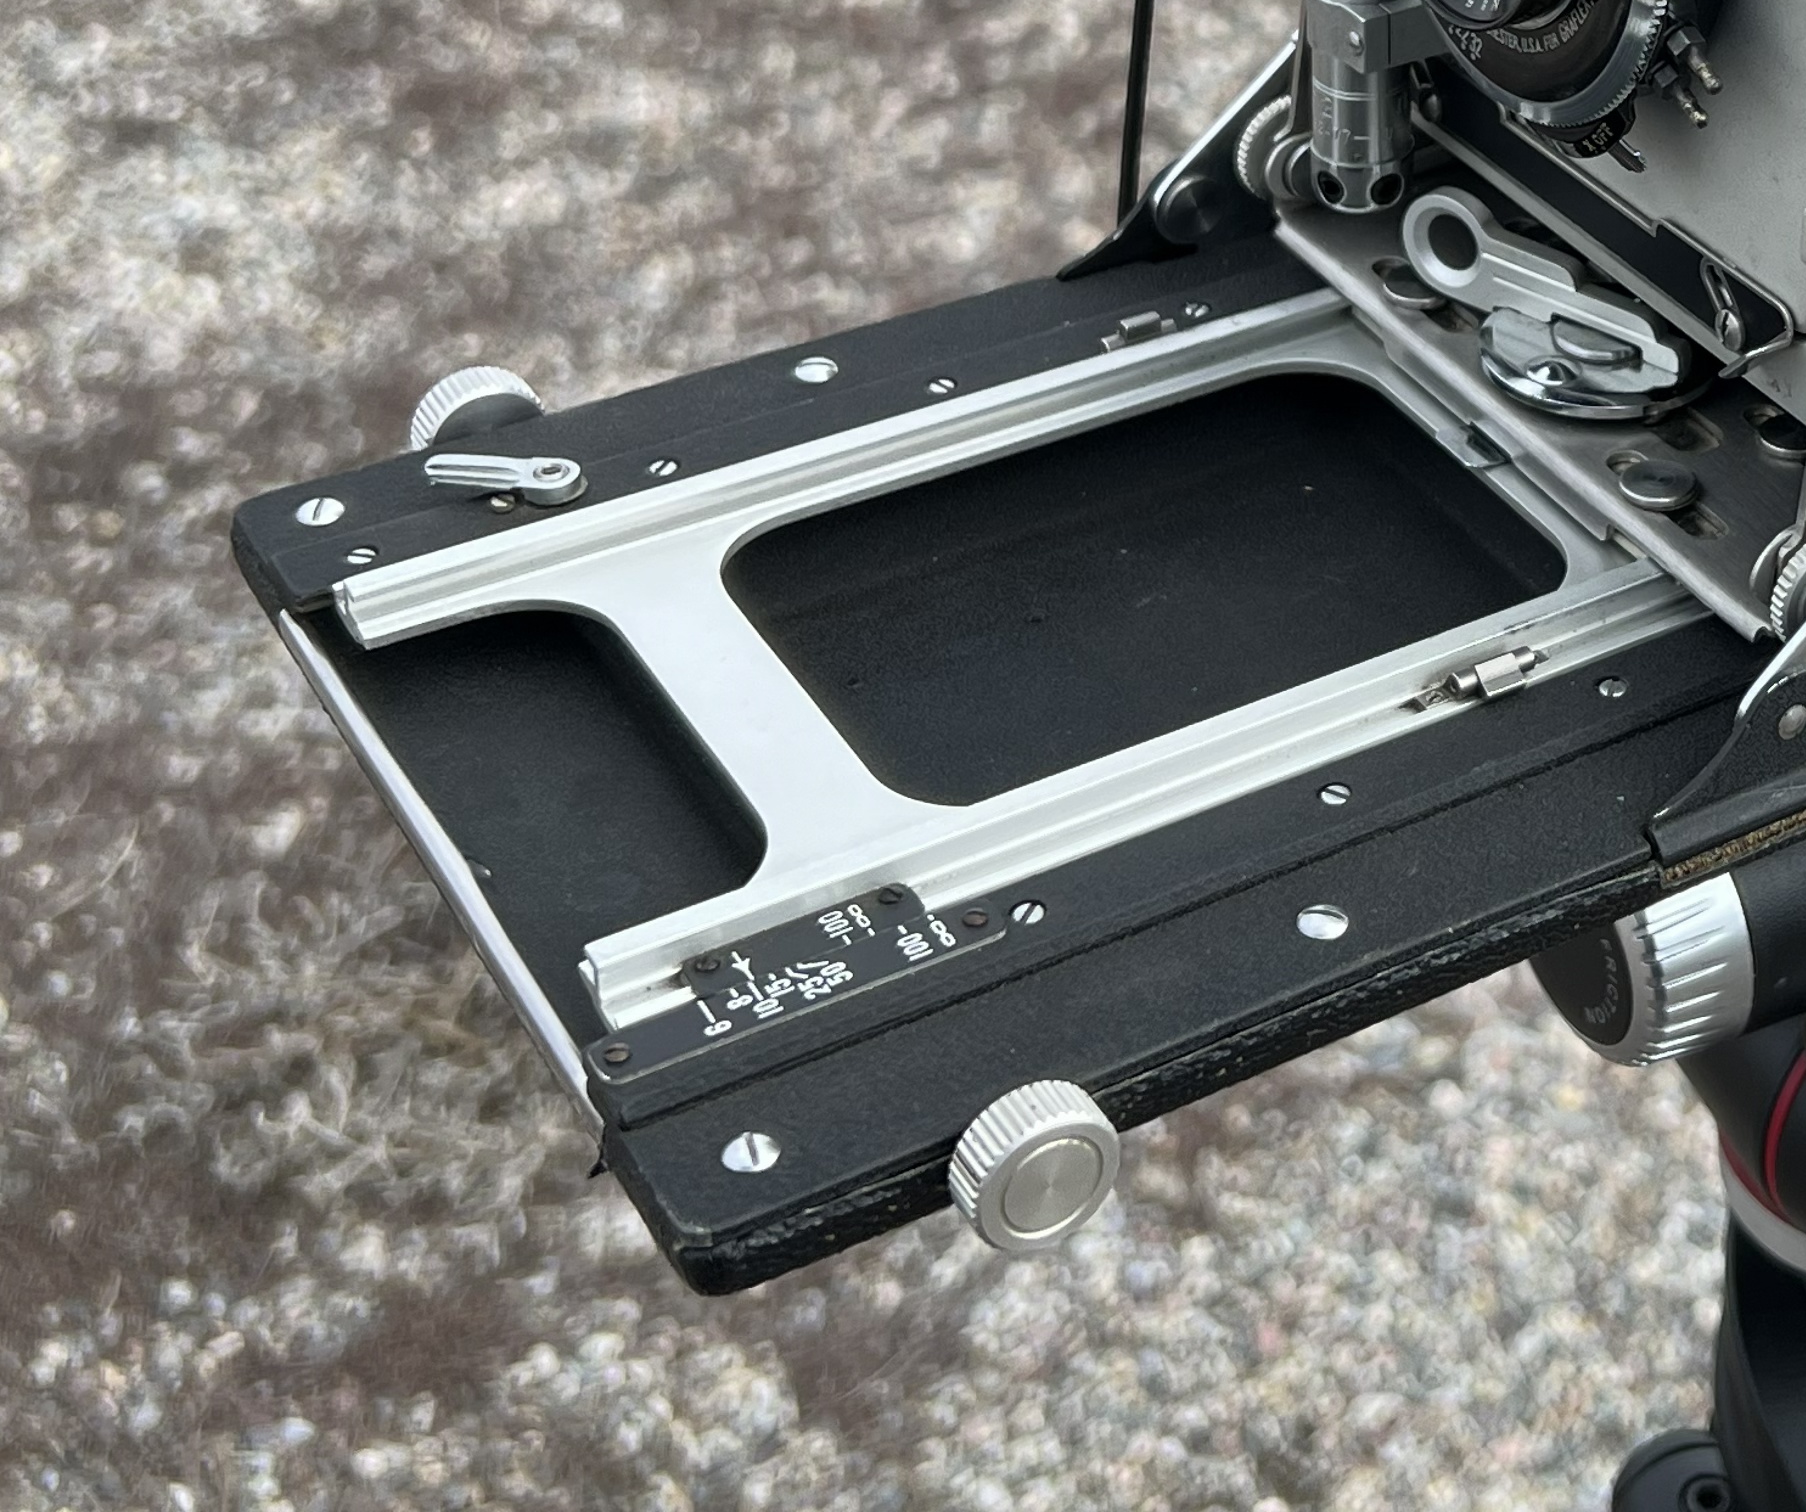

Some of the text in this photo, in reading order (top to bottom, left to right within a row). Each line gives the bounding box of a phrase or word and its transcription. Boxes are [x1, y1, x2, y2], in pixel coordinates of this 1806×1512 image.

[818, 910, 853, 939] 100
[897, 932, 934, 962] 100
[820, 961, 854, 986] 50
[764, 977, 795, 999] 15
[797, 976, 833, 1001] 25
[753, 998, 785, 1019] 10
